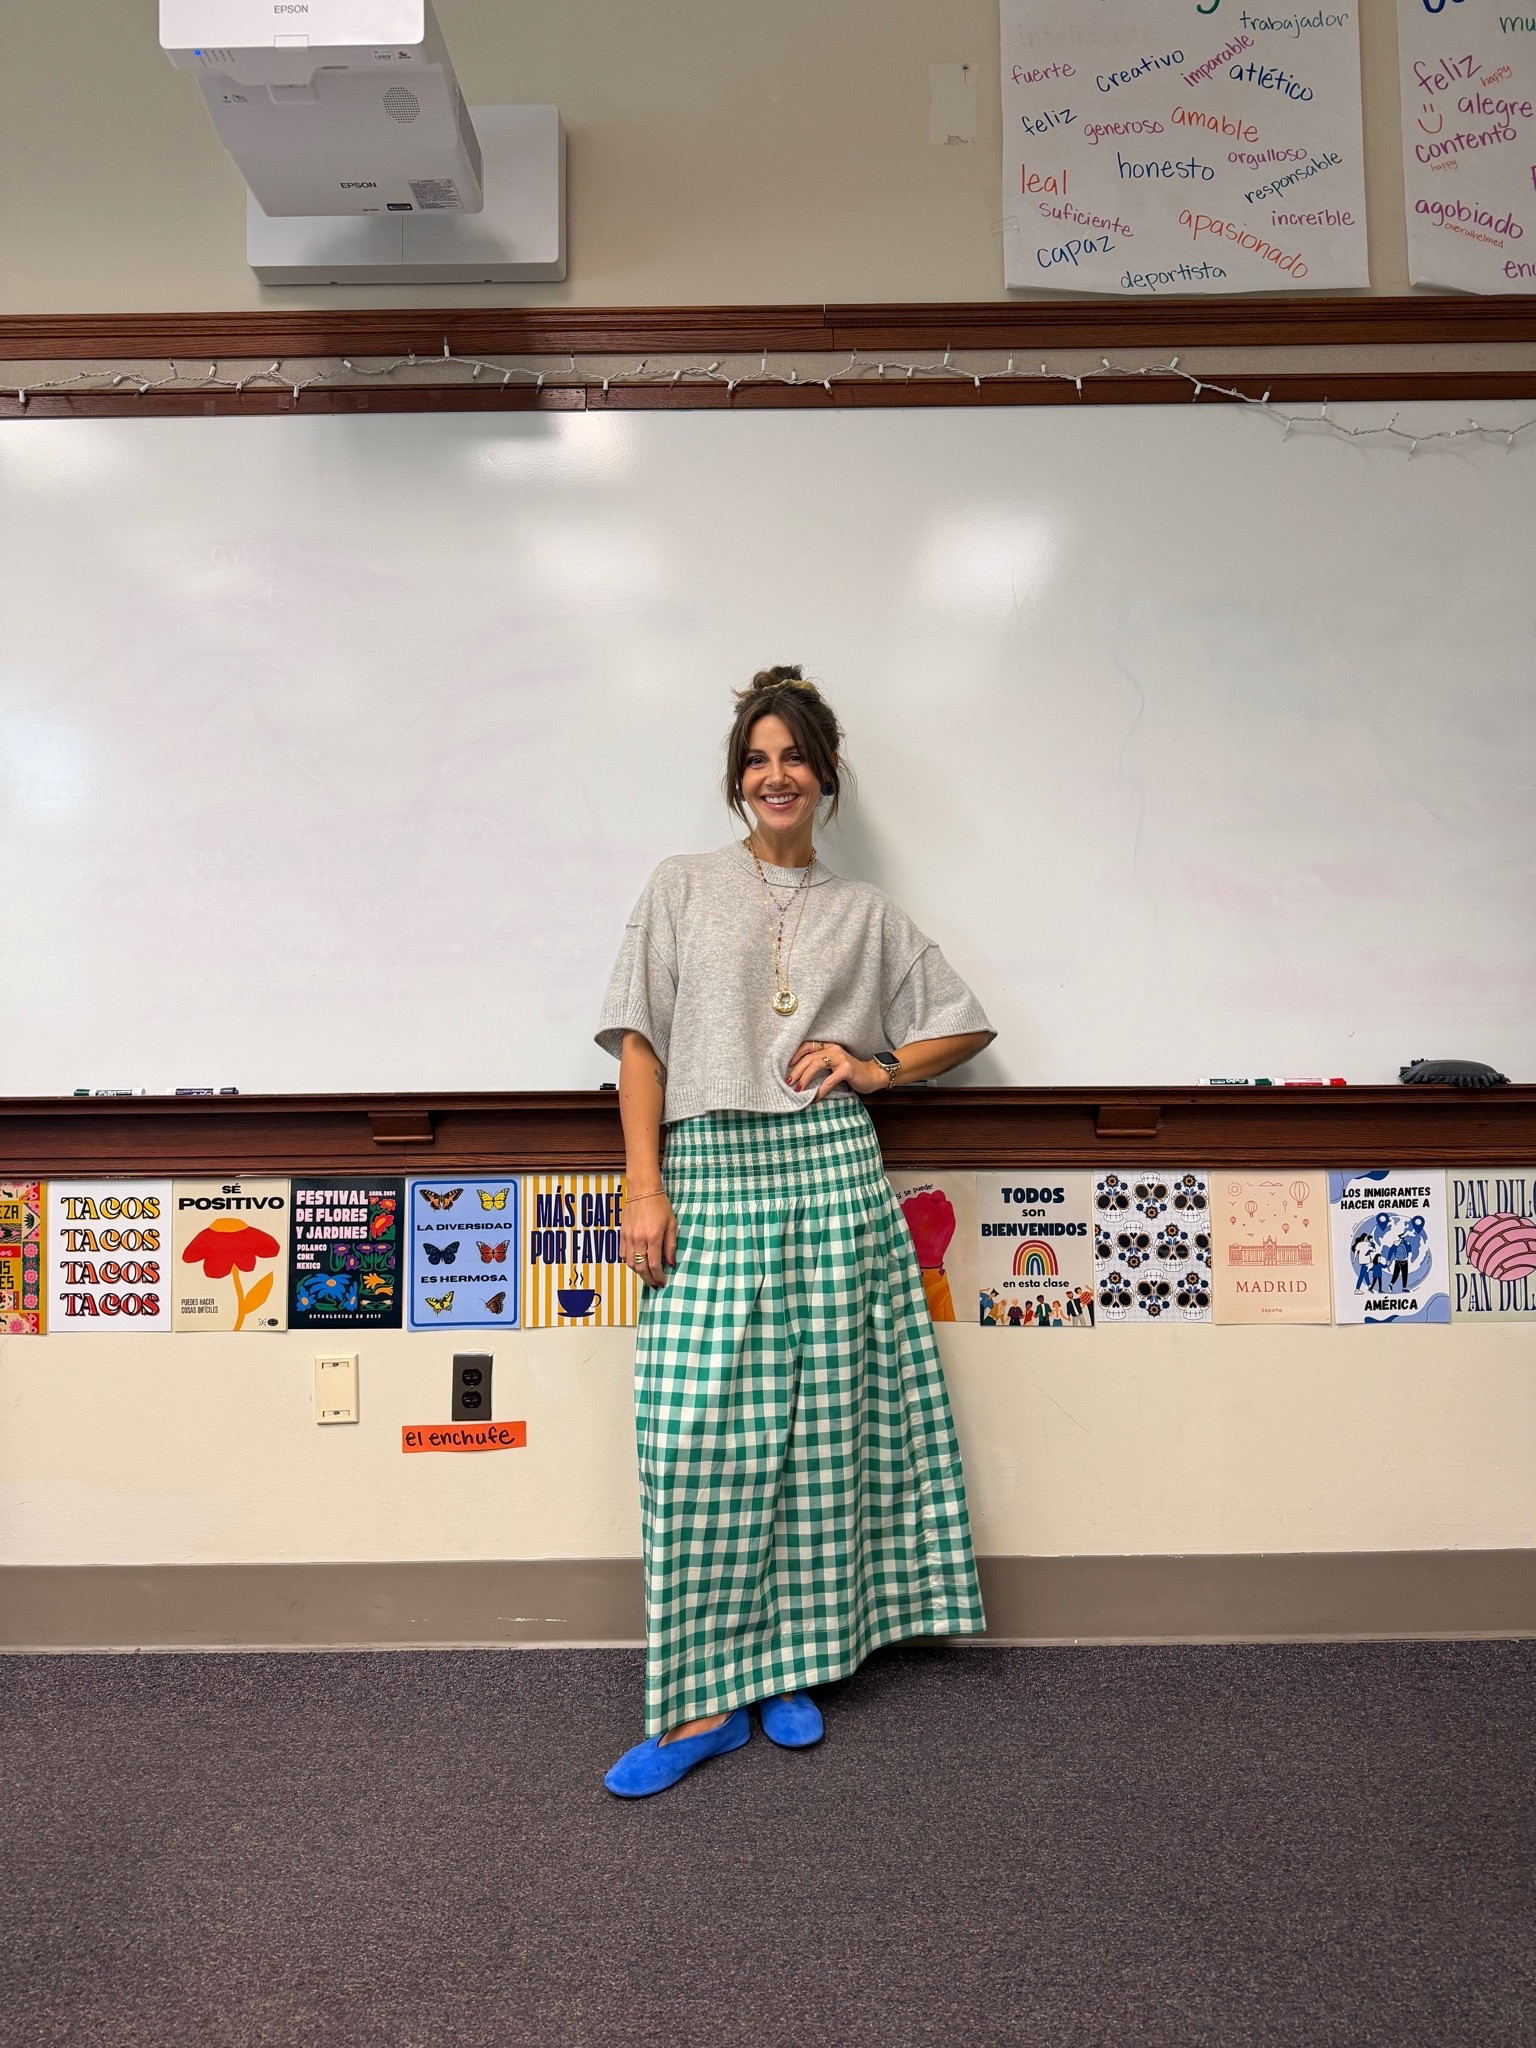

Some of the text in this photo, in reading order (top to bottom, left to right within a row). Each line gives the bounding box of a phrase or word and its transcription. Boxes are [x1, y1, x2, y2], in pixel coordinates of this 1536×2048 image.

[274, 4, 309, 14] EPSON
[1239, 10, 1349, 39] trabajador
[1180, 34, 1255, 87] imparable
[1012, 61, 1077, 85] fuerte
[1229, 62, 1314, 101] atlético
[1413, 54, 1482, 95] feliz
[1480, 65, 1512, 87] happy
[1457, 92, 1534, 129] alegre
[1021, 108, 1078, 136] feliz
[1083, 119, 1165, 146] generoso
[1171, 106, 1260, 143] amable
[1117, 151, 1215, 181] honesto
[1228, 148, 1307, 170] orgulloso
[1430, 159, 1459, 172] happy
[1020, 163, 1067, 196] leal
[1244, 151, 1343, 204] responsable
[1271, 209, 1355, 226] increíble
[1415, 199, 1524, 239] agobiado
[1178, 209, 1308, 279] apasionado
[1444, 222, 1504, 249] overwhelmed
[1037, 235, 1116, 268] capaz
[1120, 261, 1227, 292] deportista
[1503, 260, 1536, 279] en
[222, 1182, 242, 1194] SÉ
[296, 1190, 368, 1206] FESTIVAL
[1001, 1187, 1065, 1204] TODOS
[1342, 1186, 1431, 1198] LOS INMIGRANTES
[1453, 1179, 1536, 1219] PAN DUL
[60, 1196, 161, 1220] TACOS
[178, 1196, 285, 1211] POSITIVO
[536, 1184, 623, 1228] MÁS CAFÉ
[1021, 1208, 1046, 1217] son
[1340, 1198, 1430, 1210] HACEN GRANDE A
[296, 1208, 369, 1223] DE FLORES
[436, 1222, 513, 1231] DIVERSIDAD
[60, 1228, 161, 1252] TACOS
[295, 1226, 368, 1240] Y JARDINES
[981, 1222, 1088, 1237] BIENVENIDOS
[296, 1244, 328, 1252] POLANCO
[530, 1230, 567, 1265] POR
[60, 1261, 161, 1284] TACOS
[420, 1274, 508, 1283] ES HERMOSA
[1002, 1277, 1070, 1288] en esta clase
[1235, 1280, 1308, 1293] MADRID
[1455, 1273, 1492, 1312] PAN
[59, 1292, 161, 1317] TACOS
[181, 1298, 215, 1306] PUEDES HACER
[181, 1306, 197, 1314] COSAS
[1364, 1296, 1418, 1311] AMÉRICA
[405, 1426, 516, 1446] el enchufe
